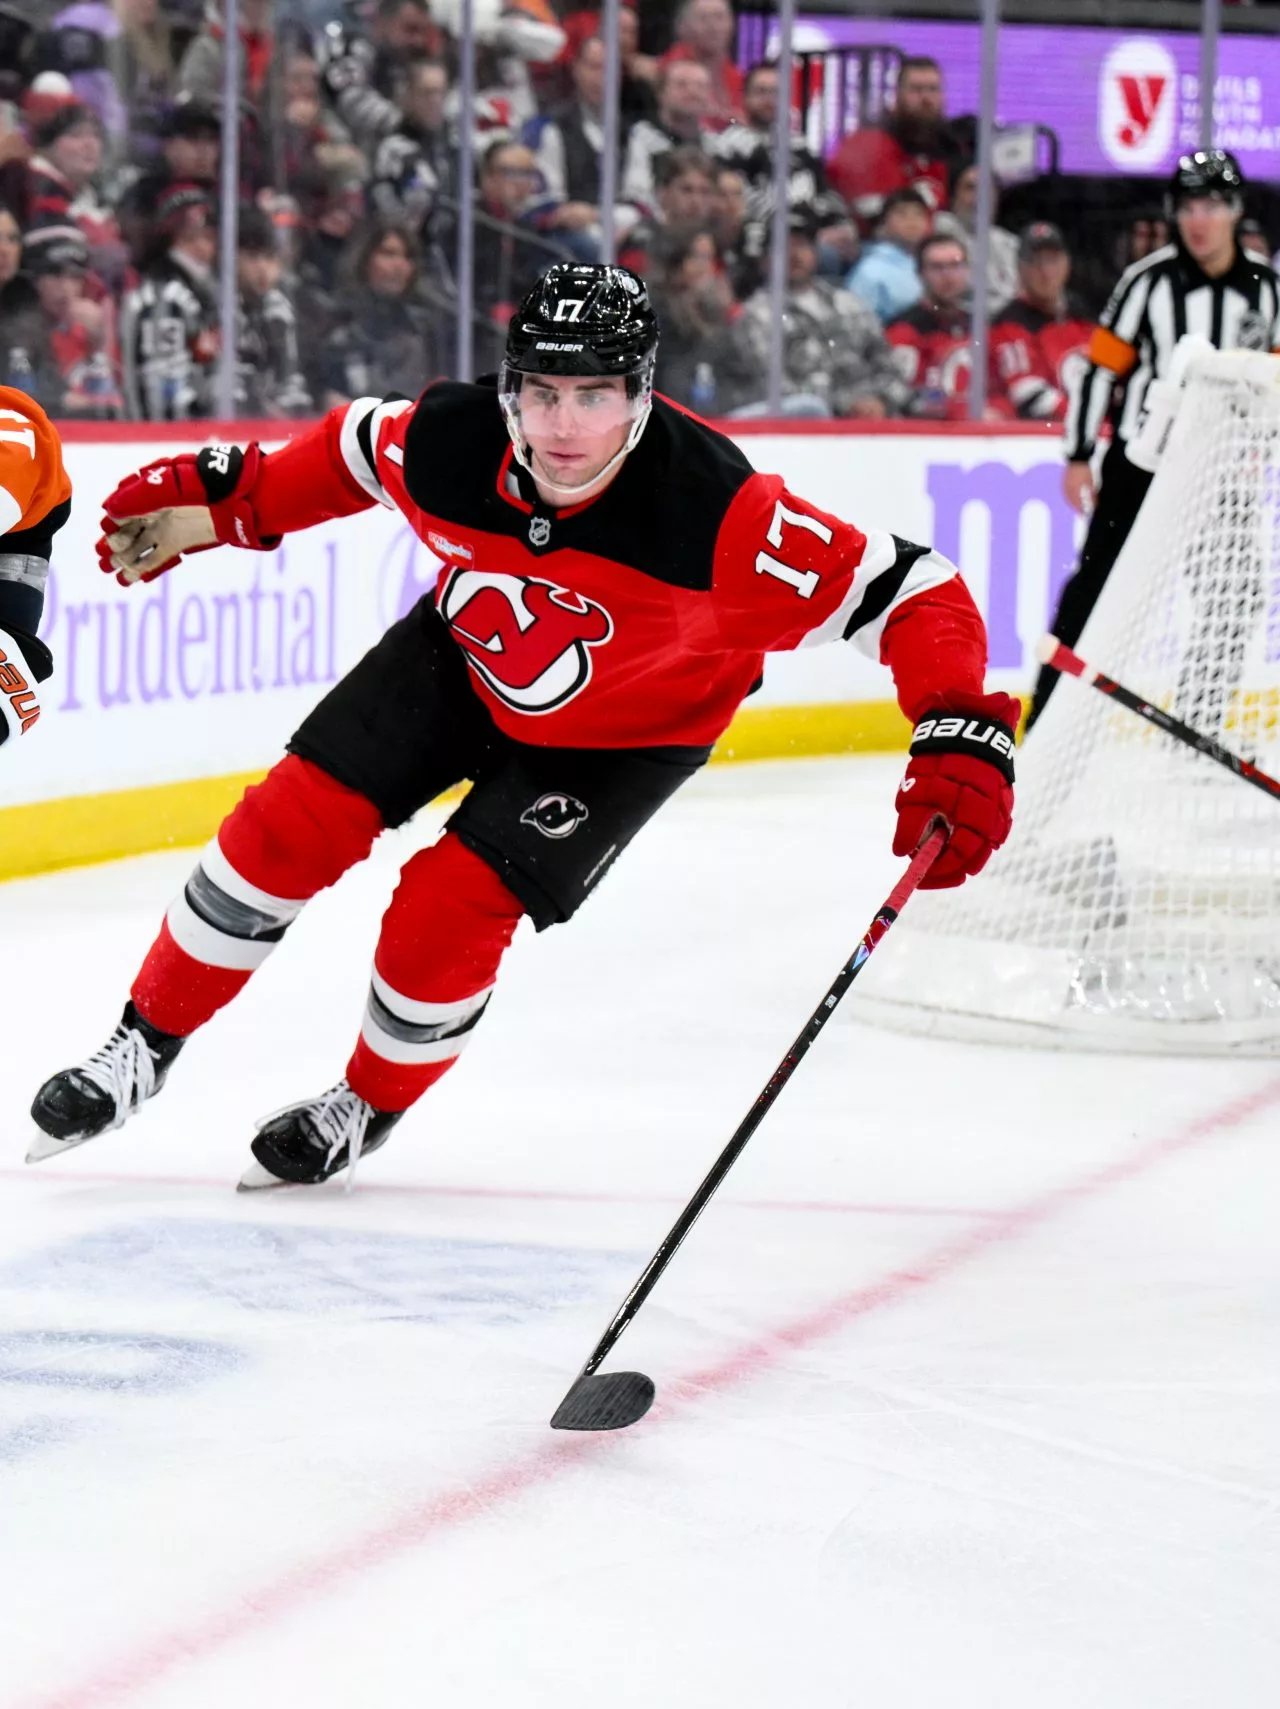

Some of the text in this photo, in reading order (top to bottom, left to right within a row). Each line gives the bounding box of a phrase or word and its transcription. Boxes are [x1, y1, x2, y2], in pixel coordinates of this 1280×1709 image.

[553, 299, 585, 322] 17
[535, 341, 584, 352] BAUER
[754, 498, 833, 599] 17
[42, 542, 339, 712] rudential
